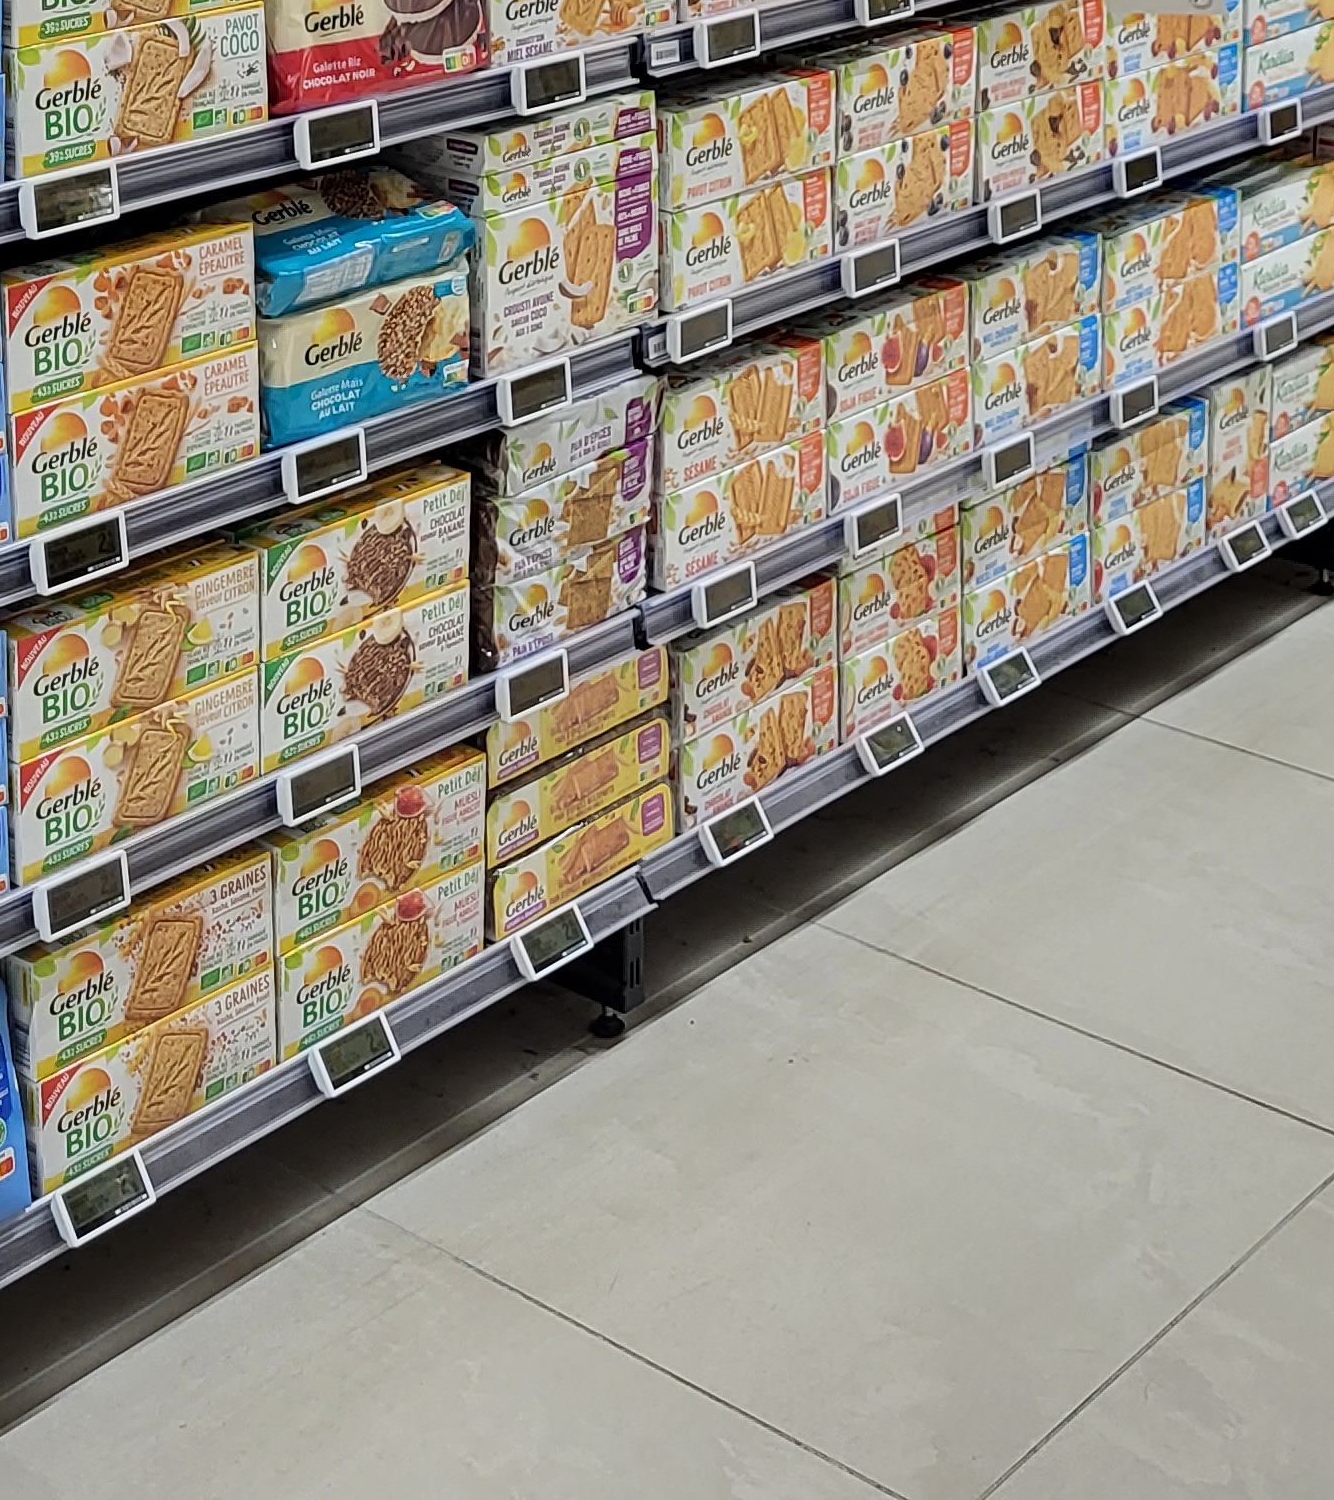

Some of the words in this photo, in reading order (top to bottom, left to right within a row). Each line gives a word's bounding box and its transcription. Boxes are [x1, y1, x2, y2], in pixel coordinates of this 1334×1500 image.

[225, 15, 259, 34] PAVOT
[220, 32, 260, 58] COCO
[44, 105, 94, 141] BIO
[198, 236, 243, 260] CARAMEL
[685, 237, 732, 267] Gerblé
[498, 248, 560, 286] Gerblé
[531, 307, 547, 323] COCO
[33, 340, 82, 377] BIO
[203, 356, 248, 380] CARAMEL
[677, 417, 724, 450] Gerblé
[39, 463, 89, 502] BIO
[683, 458, 717, 481] SÉSAME
[679, 512, 726, 545] Gerblé
[41, 680, 91, 724] BIO
[44, 801, 92, 847] BIO
[210, 888, 218, 905] 3
[220, 865, 267, 901] GRAINES
[215, 999, 223, 1015] 3
[225, 974, 270, 1014] GRAINES
[58, 995, 107, 1041] BIO
[66, 1111, 116, 1159] BIO
